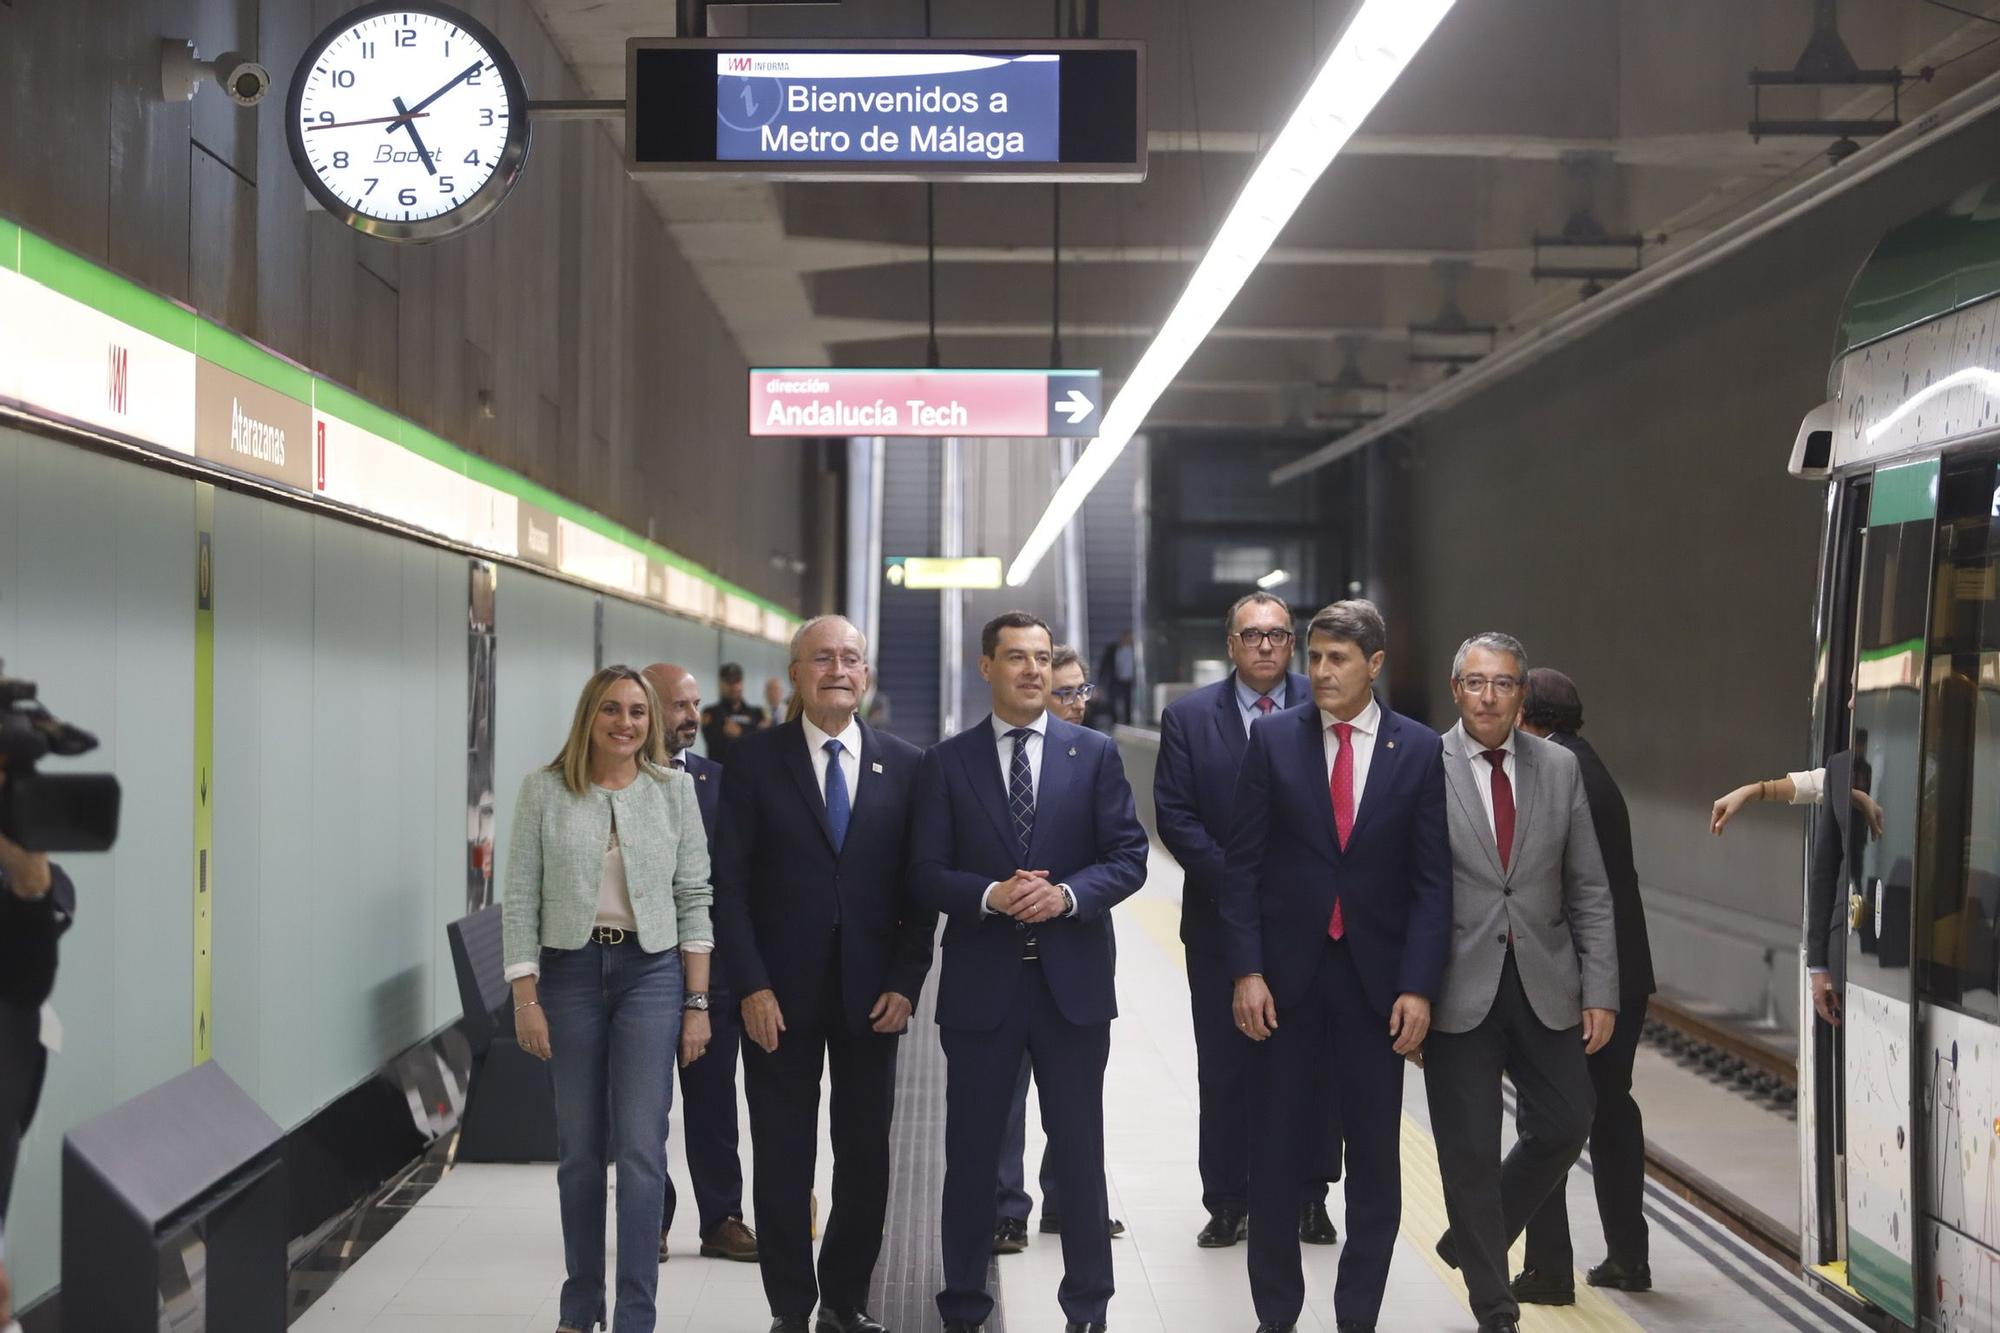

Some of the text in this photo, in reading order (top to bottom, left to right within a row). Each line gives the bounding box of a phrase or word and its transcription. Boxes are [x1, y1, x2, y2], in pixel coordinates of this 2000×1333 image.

[395, 29, 417, 47] 12
[362, 42, 375, 59] 11
[445, 40, 449, 58] 1
[754, 61, 790, 72] INFORMA
[332, 70, 355, 88] 10
[466, 66, 482, 86] 2
[788, 85, 1008, 112] Bienvenidos a
[319, 111, 335, 127] 9
[479, 108, 494, 127] 3
[761, 124, 1024, 159] Metro de Málaga
[332, 151, 350, 169] 8
[463, 149, 480, 166] 4
[363, 178, 379, 195] 7
[439, 176, 454, 193] 5
[398, 188, 417, 206] 6
[766, 378, 829, 393] dirección
[766, 399, 967, 426] Andalucía Tech
[231, 396, 285, 467] Atarazanas
